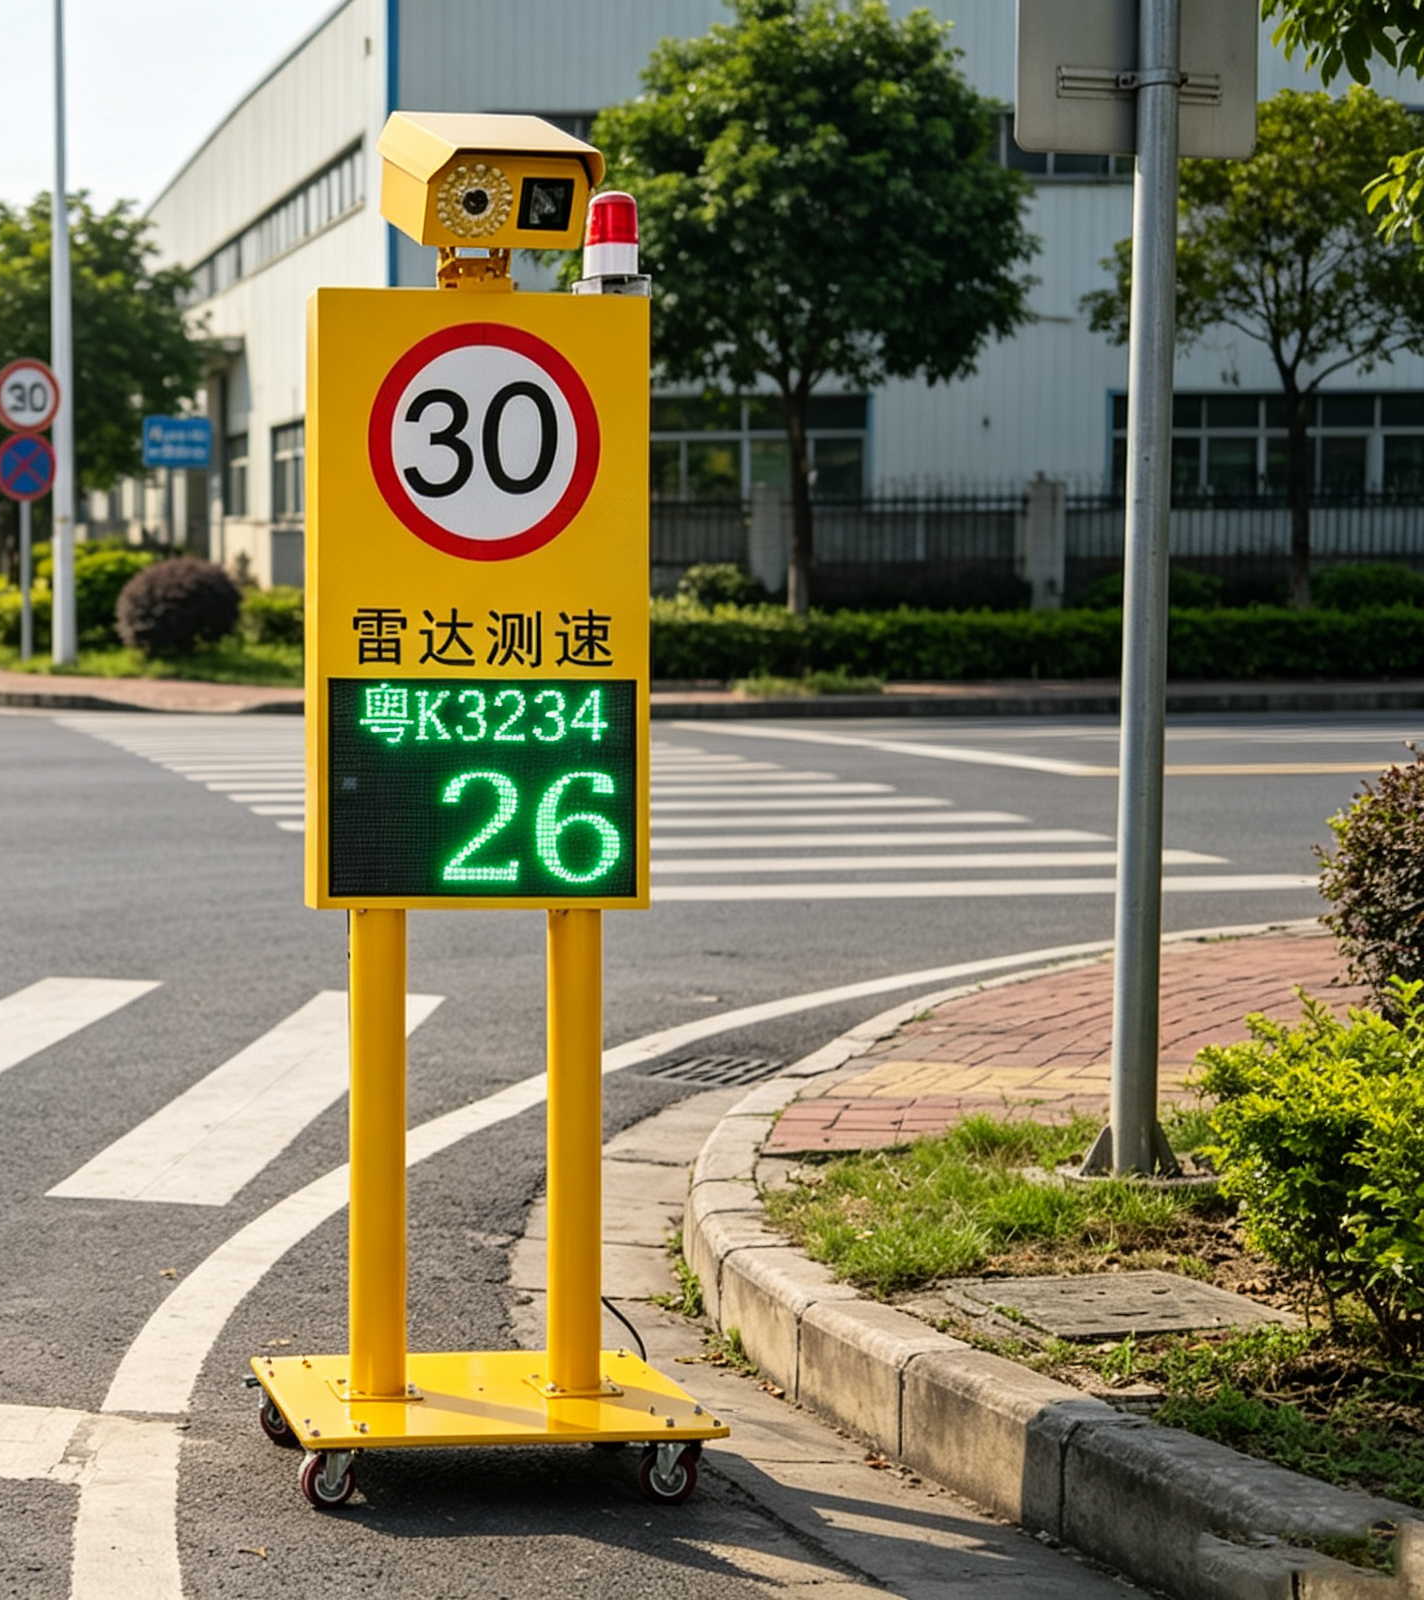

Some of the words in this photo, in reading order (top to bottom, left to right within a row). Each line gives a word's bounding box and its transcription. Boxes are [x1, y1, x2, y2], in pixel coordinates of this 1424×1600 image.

[8, 382, 47, 413] 30
[403, 381, 559, 499] 30
[352, 608, 614, 668] 雷达测速
[359, 683, 610, 746] 粤K3234
[442, 770, 621, 885] 26
